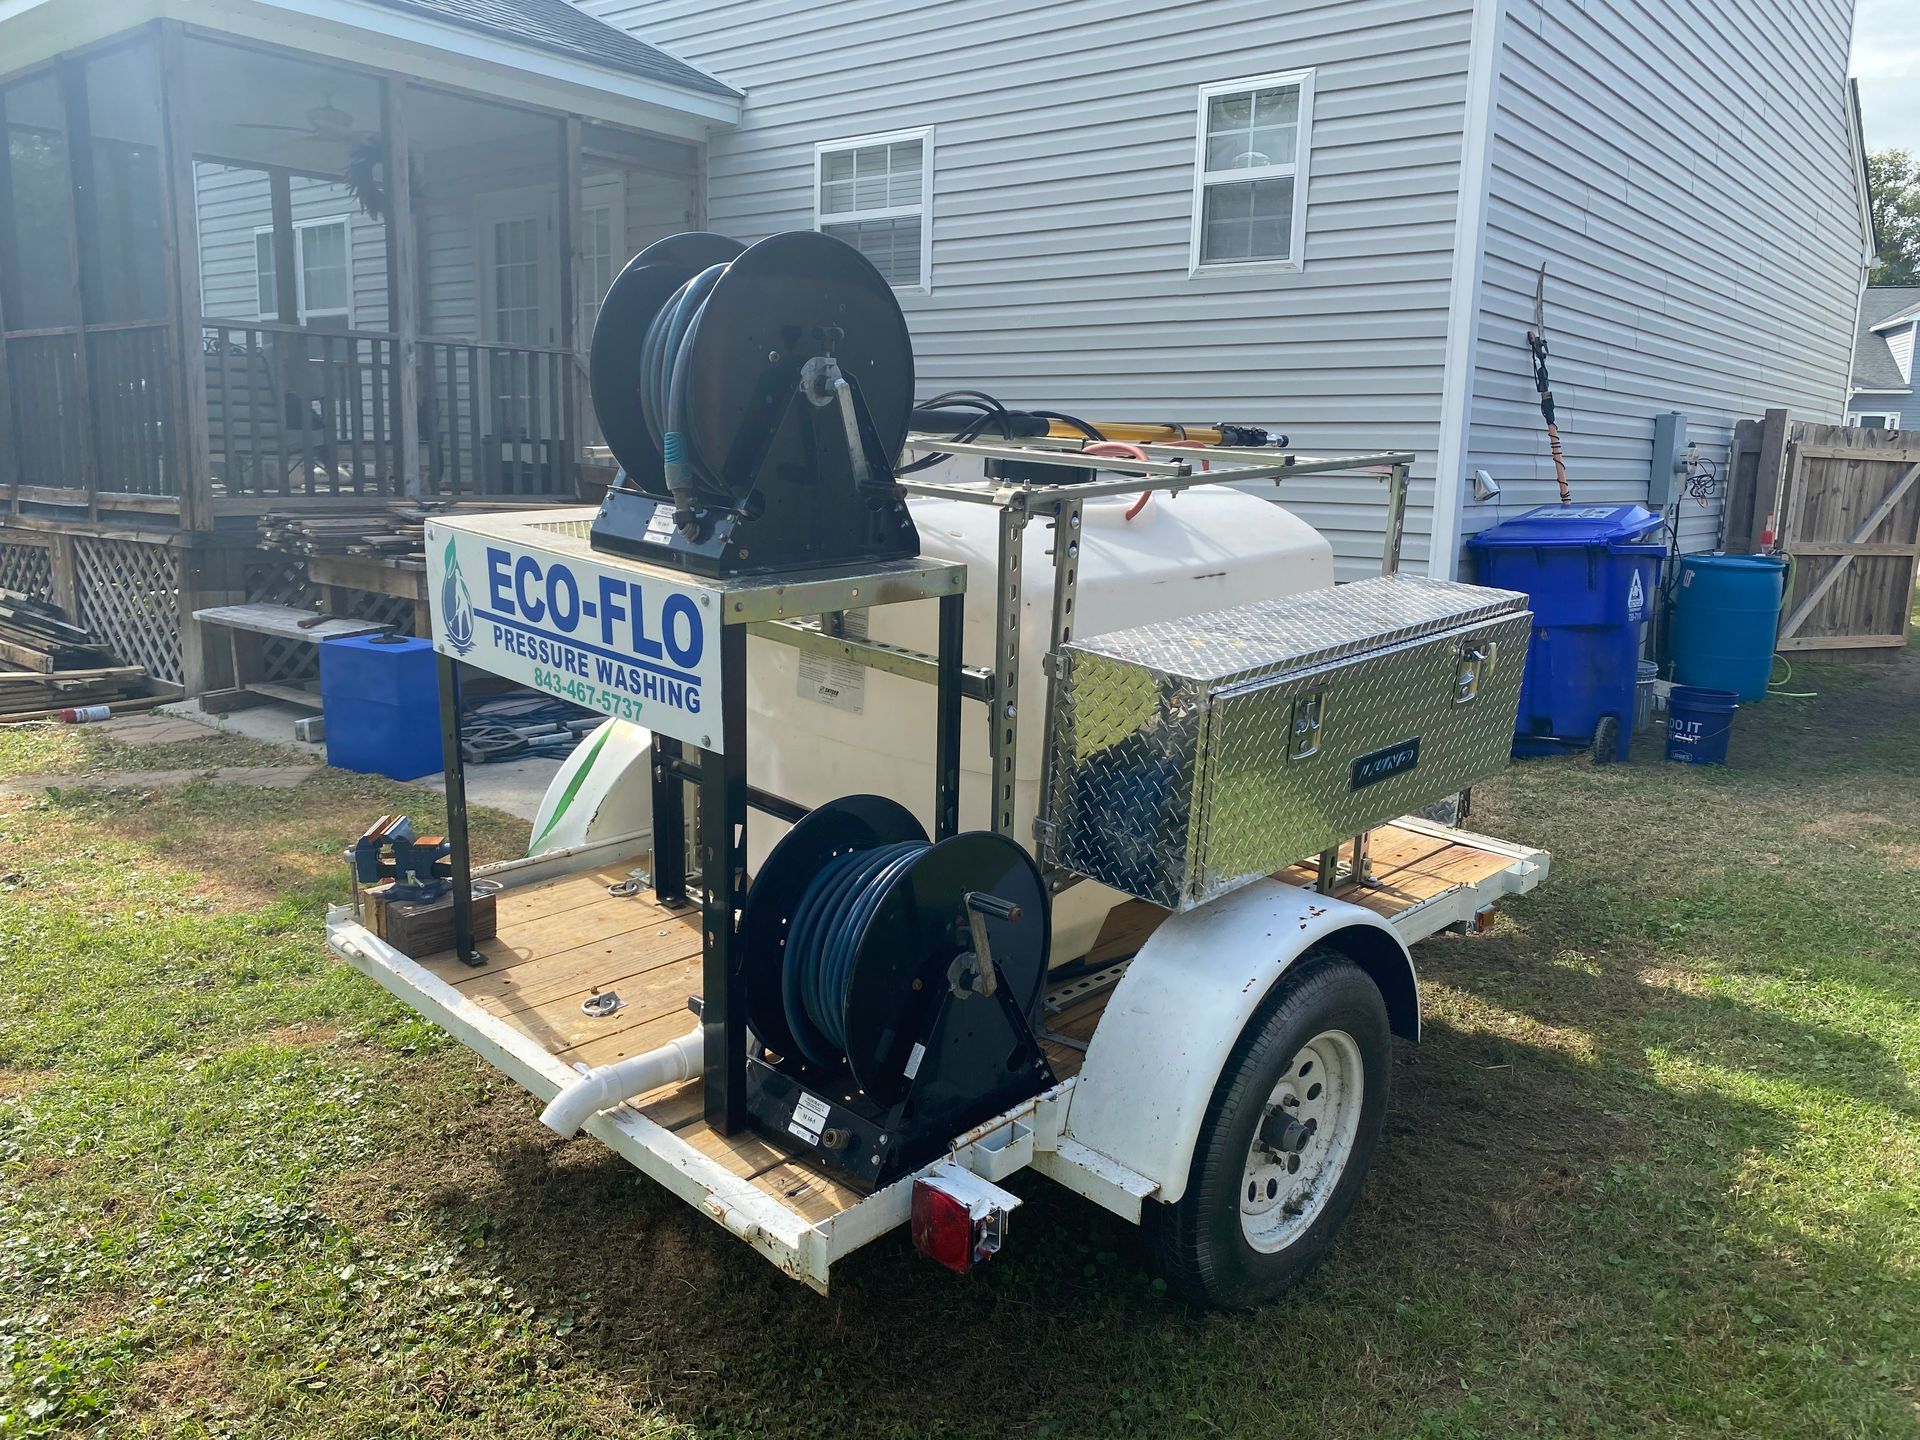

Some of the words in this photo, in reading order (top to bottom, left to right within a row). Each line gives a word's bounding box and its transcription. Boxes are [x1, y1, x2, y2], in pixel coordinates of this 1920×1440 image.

[487, 547, 703, 668] ECO-FLO
[493, 625, 589, 678] PRESSURE
[595, 658, 700, 714] WASHING
[534, 667, 643, 721] 843-467-5737
[1669, 718, 1683, 731] DO
[1687, 721, 1703, 733] IT
